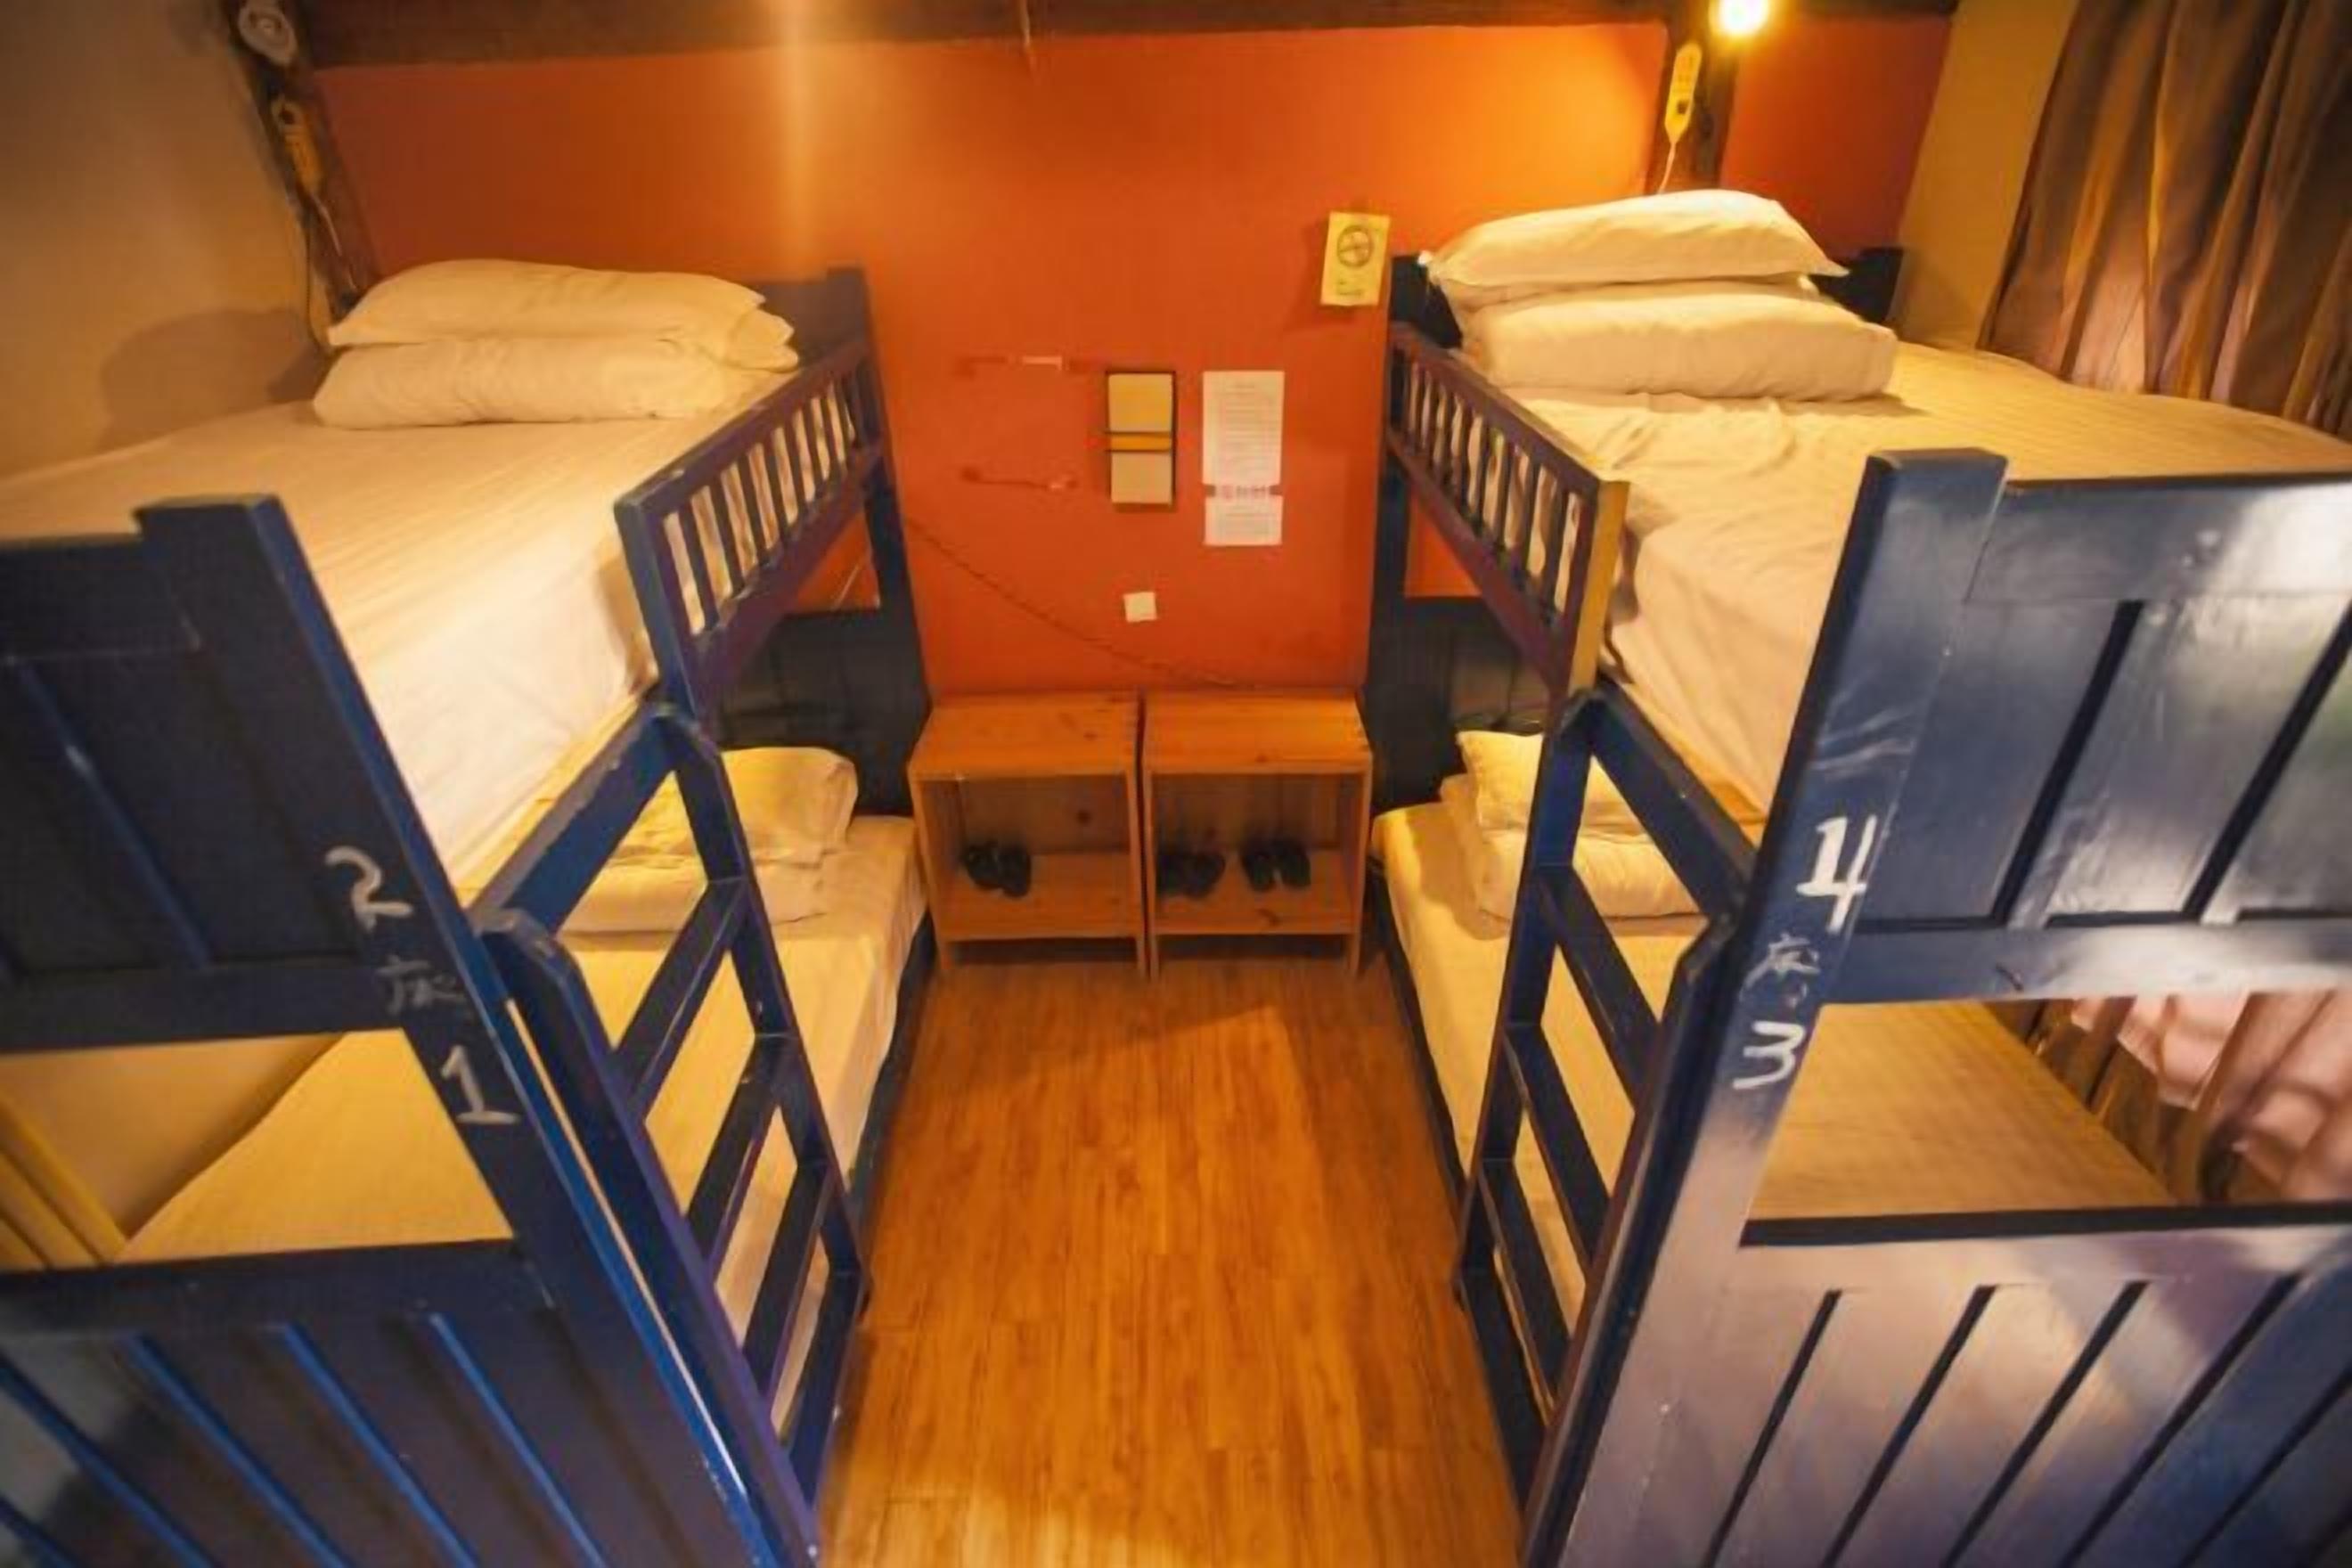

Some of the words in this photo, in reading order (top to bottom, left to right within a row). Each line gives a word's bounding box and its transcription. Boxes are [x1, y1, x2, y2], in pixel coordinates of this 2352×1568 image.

[324, 845, 413, 932] 2
[1796, 815, 1876, 934] 4
[442, 1045, 520, 1124] 1
[1733, 1020, 1805, 1090] 3
